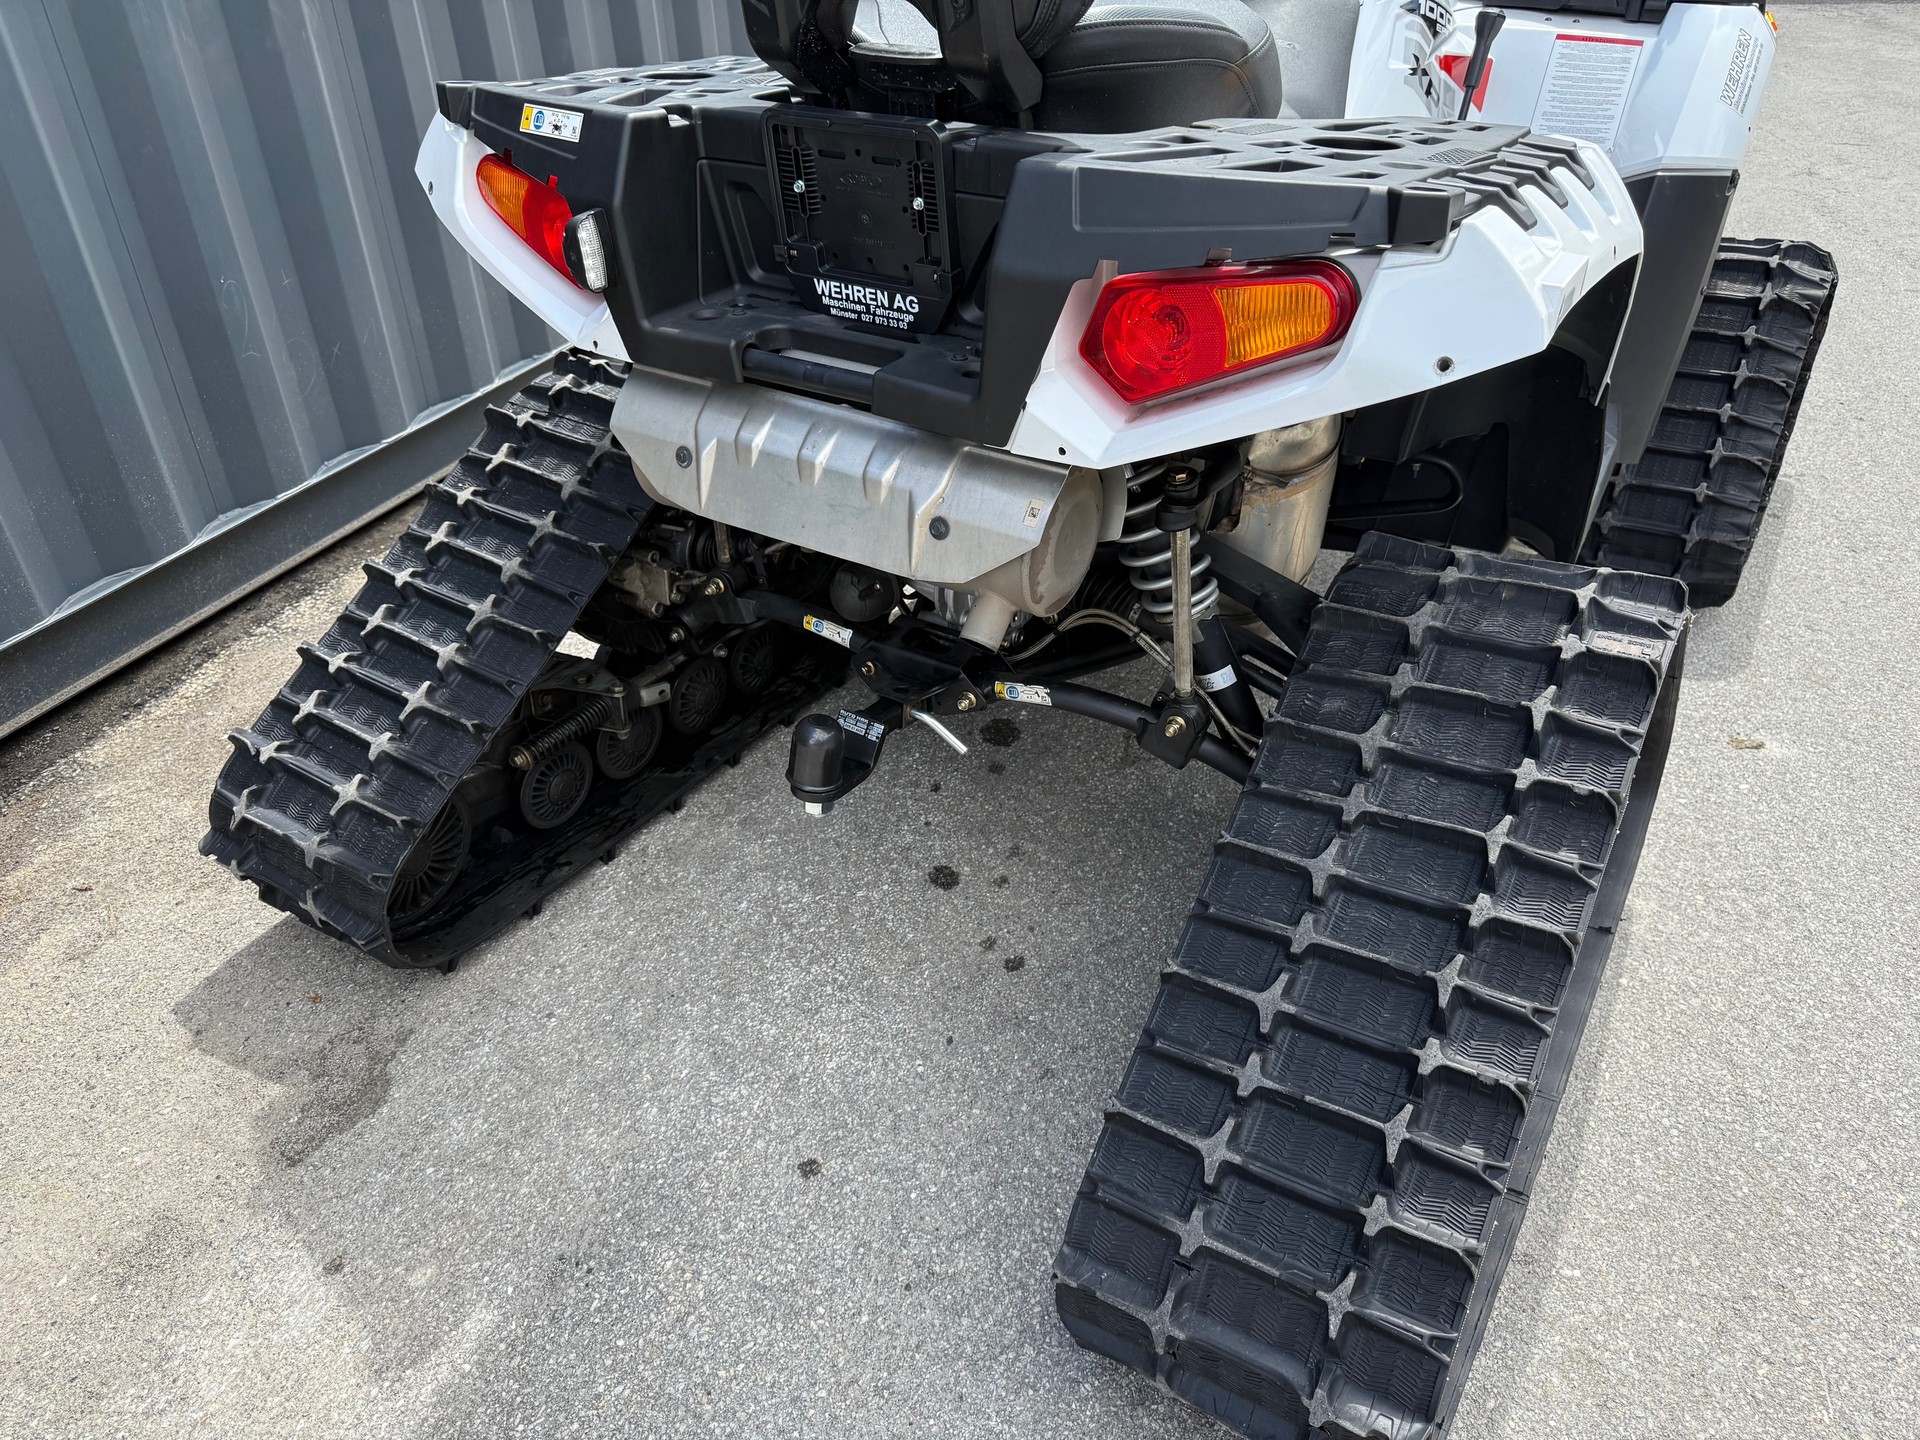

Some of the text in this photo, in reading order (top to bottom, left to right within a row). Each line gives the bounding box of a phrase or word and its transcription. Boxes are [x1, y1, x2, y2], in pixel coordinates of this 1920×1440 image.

[1720, 28, 1752, 106] WEHREN
[813, 277, 920, 313] WEHREN AG
[821, 295, 914, 323] Maschinen Fahrzeuge
[830, 307, 908, 330] Münster 027 973 33 03
